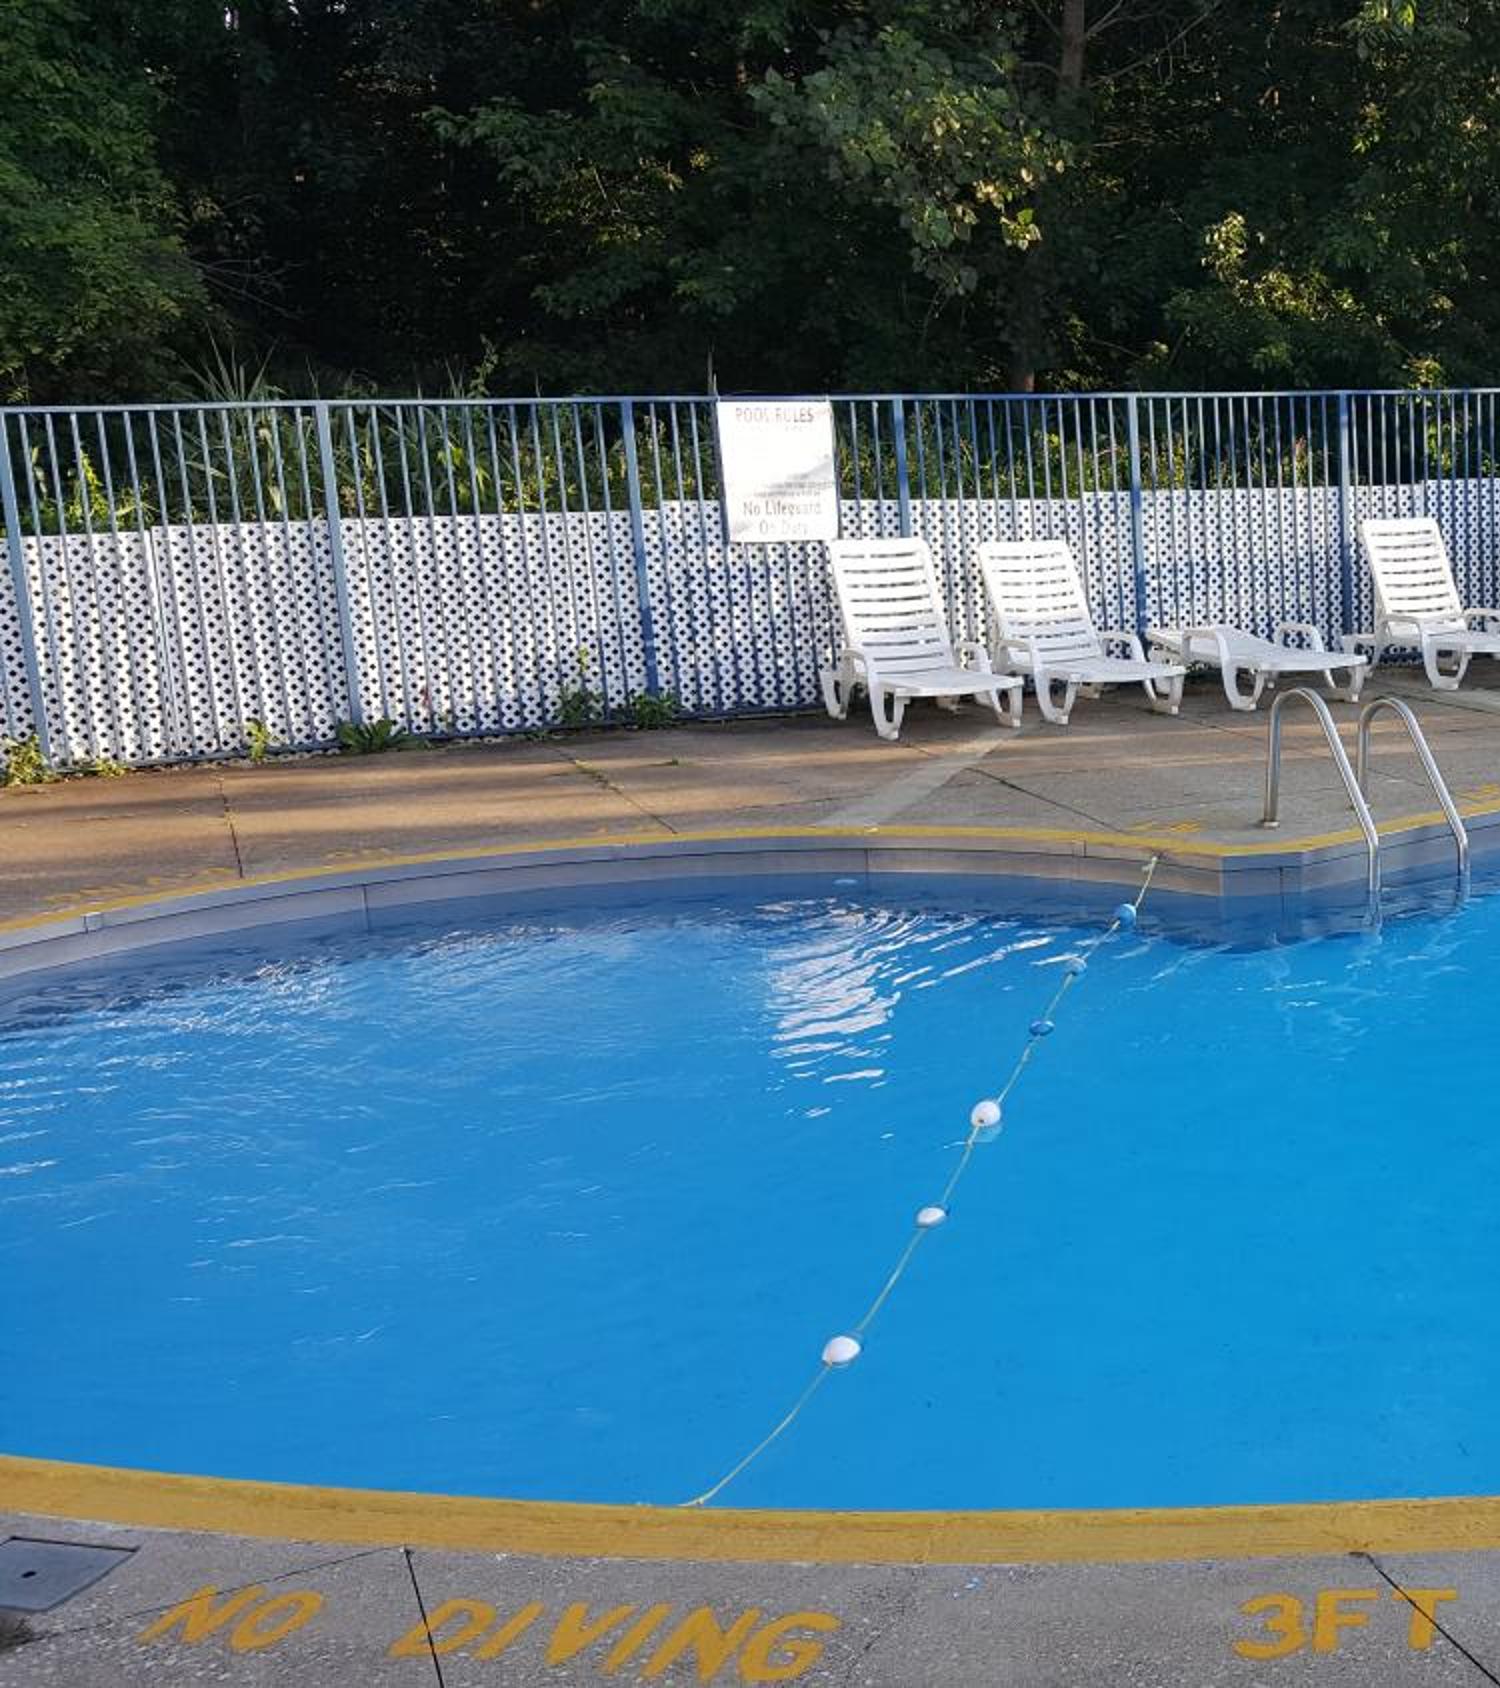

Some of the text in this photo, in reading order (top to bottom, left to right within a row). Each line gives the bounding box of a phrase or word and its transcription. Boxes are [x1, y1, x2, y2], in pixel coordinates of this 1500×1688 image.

[735, 407, 814, 423] POOL RULES
[743, 500, 822, 517] No Lifeguard
[138, 1585, 840, 1682] NO DIVING
[1234, 1588, 1457, 1660] 3FT
